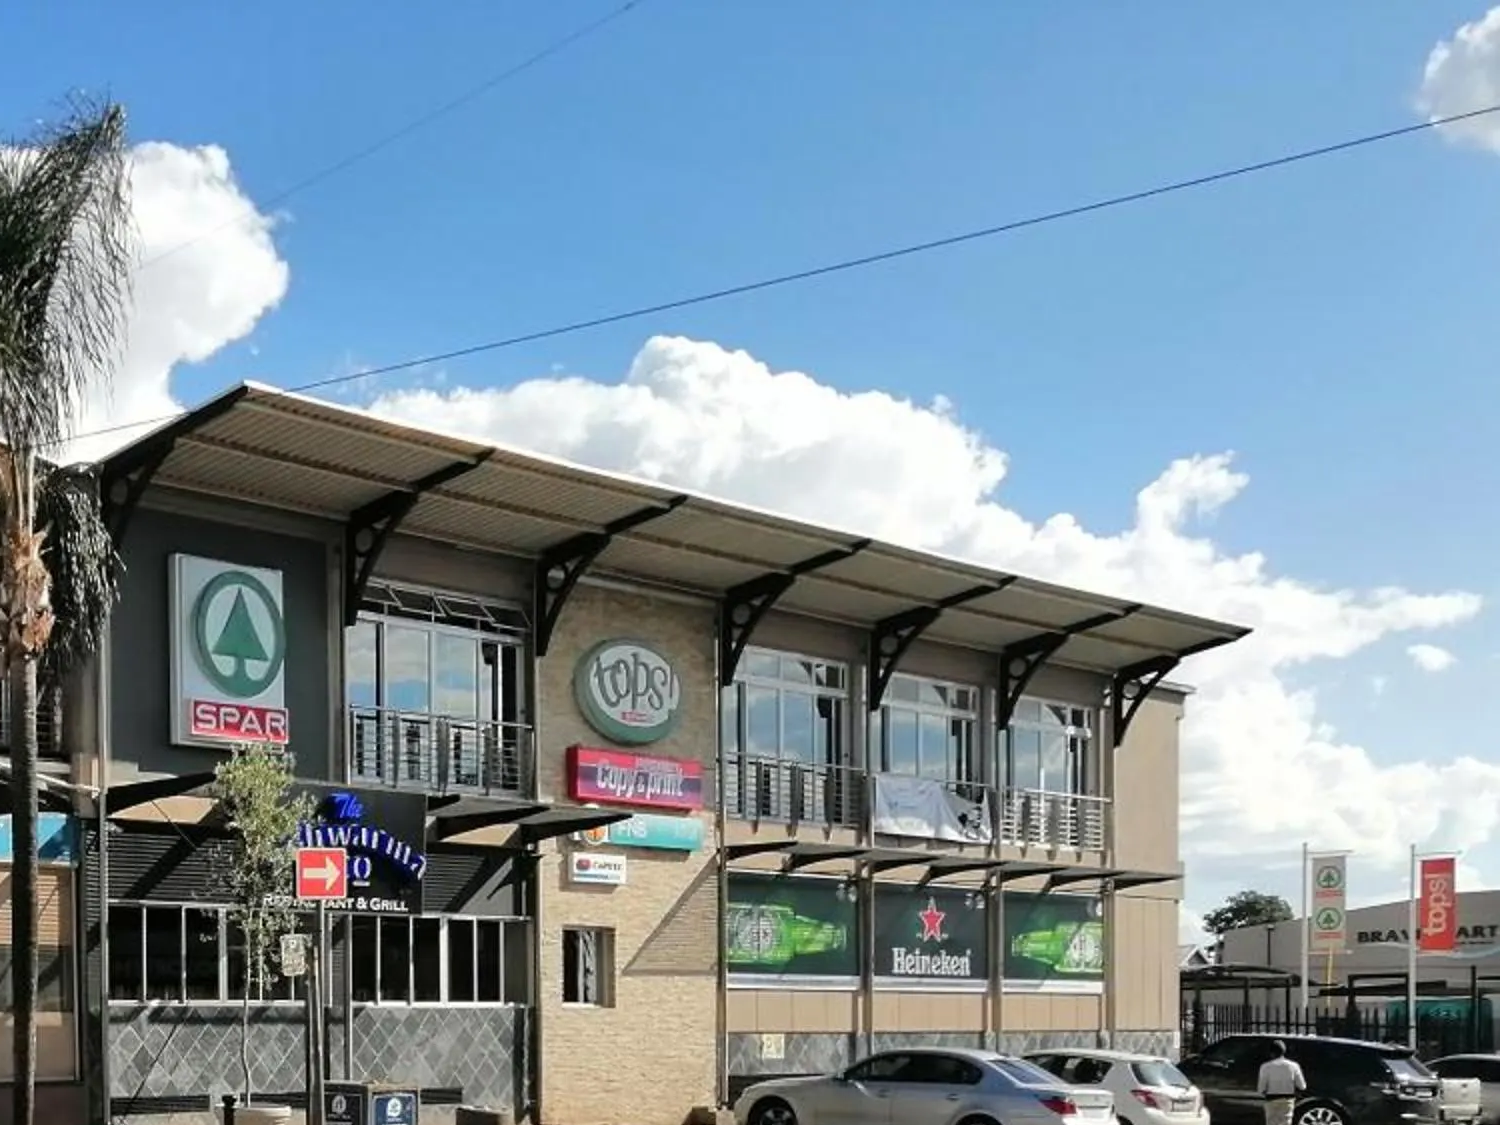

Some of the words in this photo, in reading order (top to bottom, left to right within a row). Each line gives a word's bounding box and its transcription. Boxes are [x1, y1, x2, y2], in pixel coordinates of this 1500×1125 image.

[196, 704, 285, 738] SPAR
[356, 897, 367, 910] &
[369, 898, 408, 912] GRILL
[1424, 873, 1452, 936] tops!
[891, 947, 971, 976] Heineken
